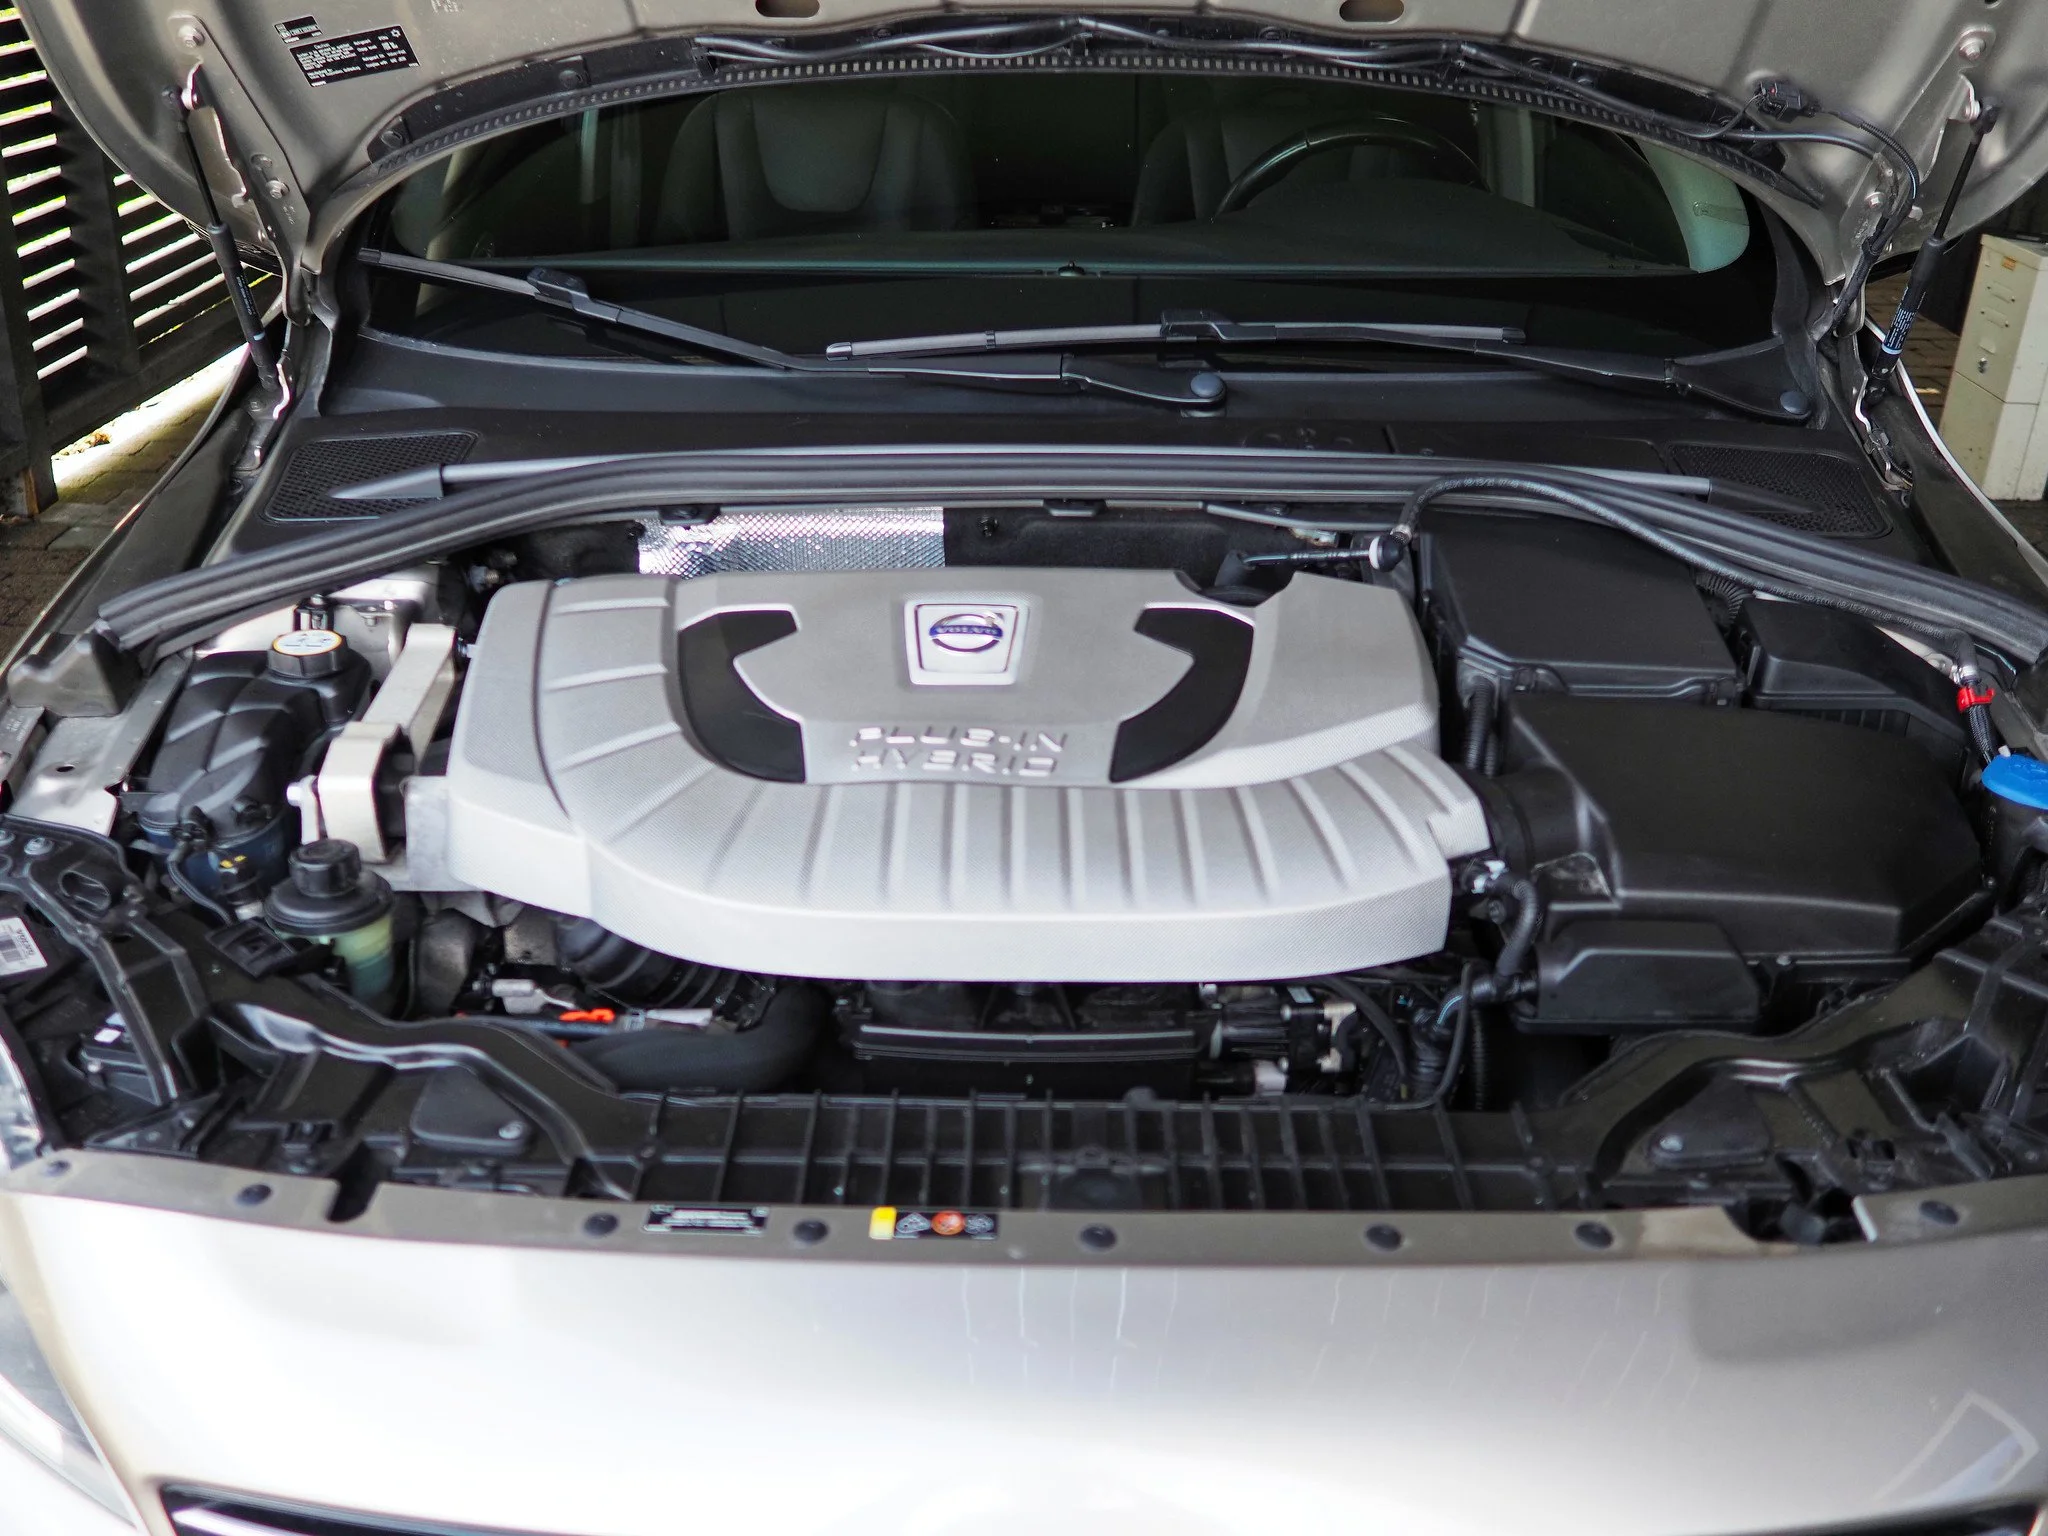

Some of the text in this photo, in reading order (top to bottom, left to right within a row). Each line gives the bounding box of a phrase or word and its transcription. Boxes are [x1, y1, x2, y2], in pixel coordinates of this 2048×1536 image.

[935, 626, 999, 635] VOLVO
[849, 726, 1068, 752] PLUG-IN
[850, 748, 1058, 778] HYBRID
